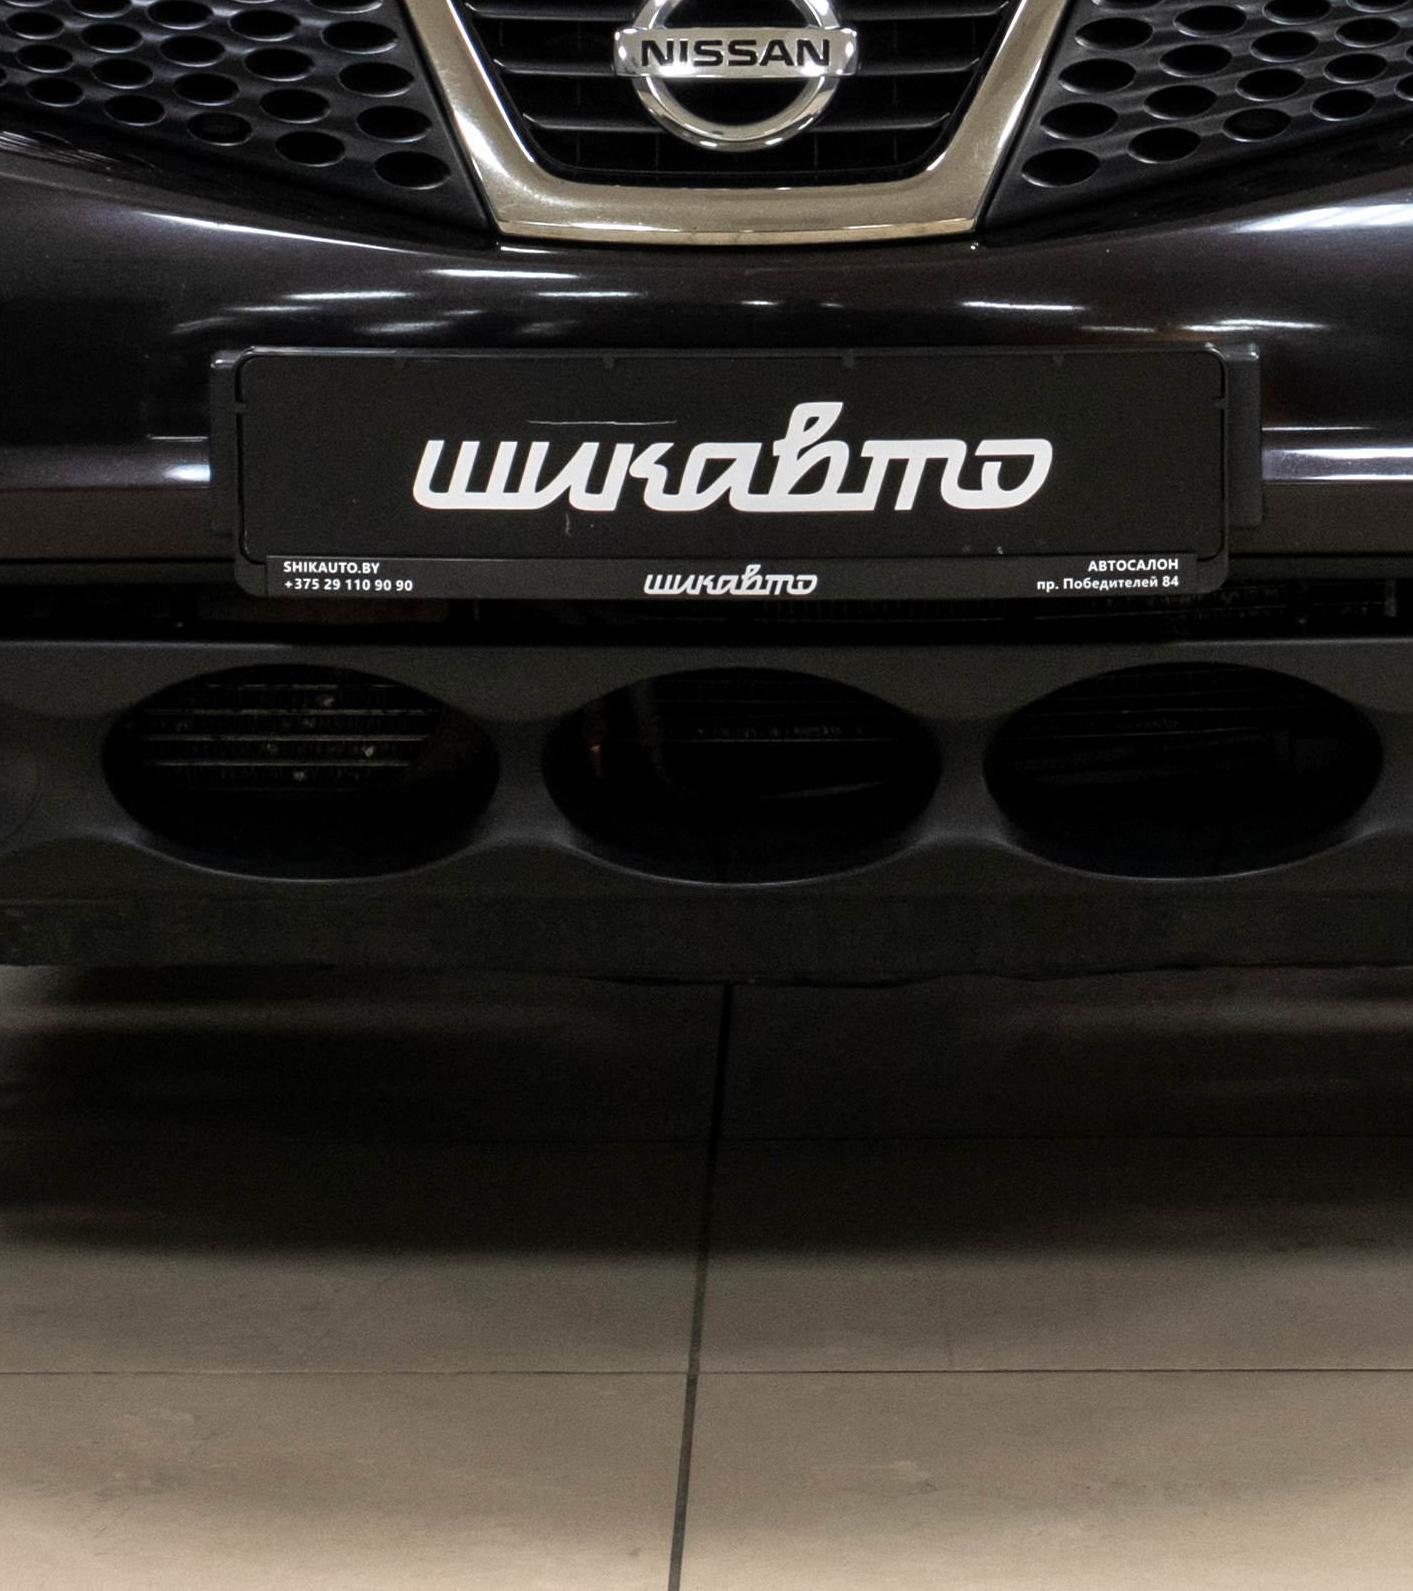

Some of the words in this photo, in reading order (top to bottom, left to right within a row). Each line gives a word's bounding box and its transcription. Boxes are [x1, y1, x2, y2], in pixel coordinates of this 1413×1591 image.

[640, 38, 830, 67] NISSAN
[283, 561, 380, 574] SHIKAUTO.BY
[1088, 558, 1179, 572] АВТОСАЛОН
[284, 578, 320, 590] +375
[323, 578, 341, 591] 29
[345, 579, 371, 591] 110
[374, 579, 392, 591] 90
[395, 579, 413, 592] 90
[1036, 580, 1059, 593] пр.
[1063, 575, 1158, 591] Победителей
[1161, 575, 1180, 587] 84
